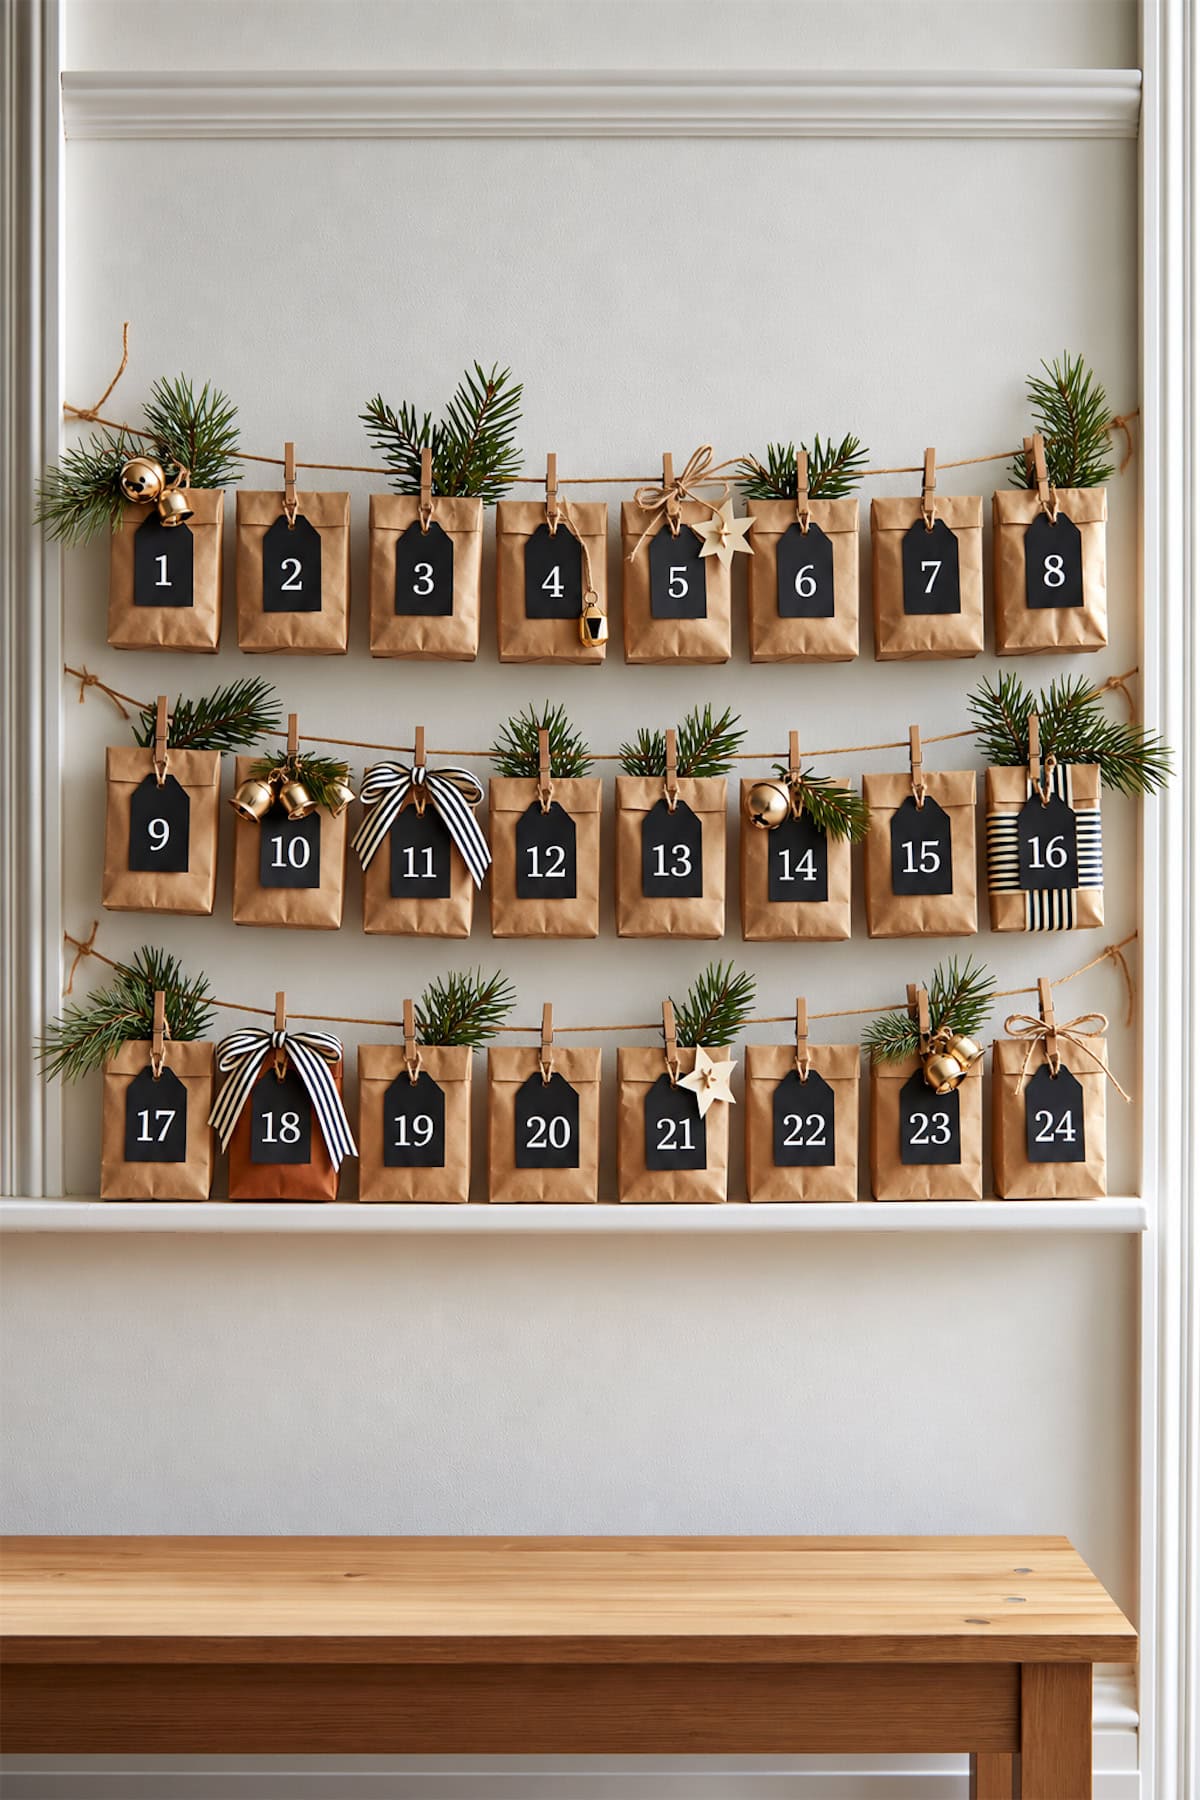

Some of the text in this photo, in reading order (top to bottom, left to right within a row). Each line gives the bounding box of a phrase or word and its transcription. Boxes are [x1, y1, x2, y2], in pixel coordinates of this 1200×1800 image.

[155, 554, 172, 586] 1
[280, 558, 303, 591] 2
[412, 562, 435, 596] 3
[541, 565, 565, 598] 4
[668, 566, 689, 599] 5
[794, 564, 817, 598] 6
[921, 560, 942, 594] 7
[1043, 554, 1066, 588] 8
[148, 818, 170, 851] 9
[271, 835, 310, 869] 10
[403, 846, 437, 878] 11
[526, 845, 566, 878] 12
[652, 844, 692, 877] 13
[778, 848, 818, 881] 14
[901, 840, 941, 873] 15
[1027, 835, 1068, 869] 16
[136, 1109, 176, 1142] 17
[261, 1111, 301, 1144] 18
[394, 1114, 434, 1147] 19
[526, 1115, 571, 1149] 20
[656, 1118, 696, 1150] 21
[783, 1113, 826, 1146] 22
[909, 1112, 951, 1145] 23
[1034, 1110, 1076, 1143] 24
